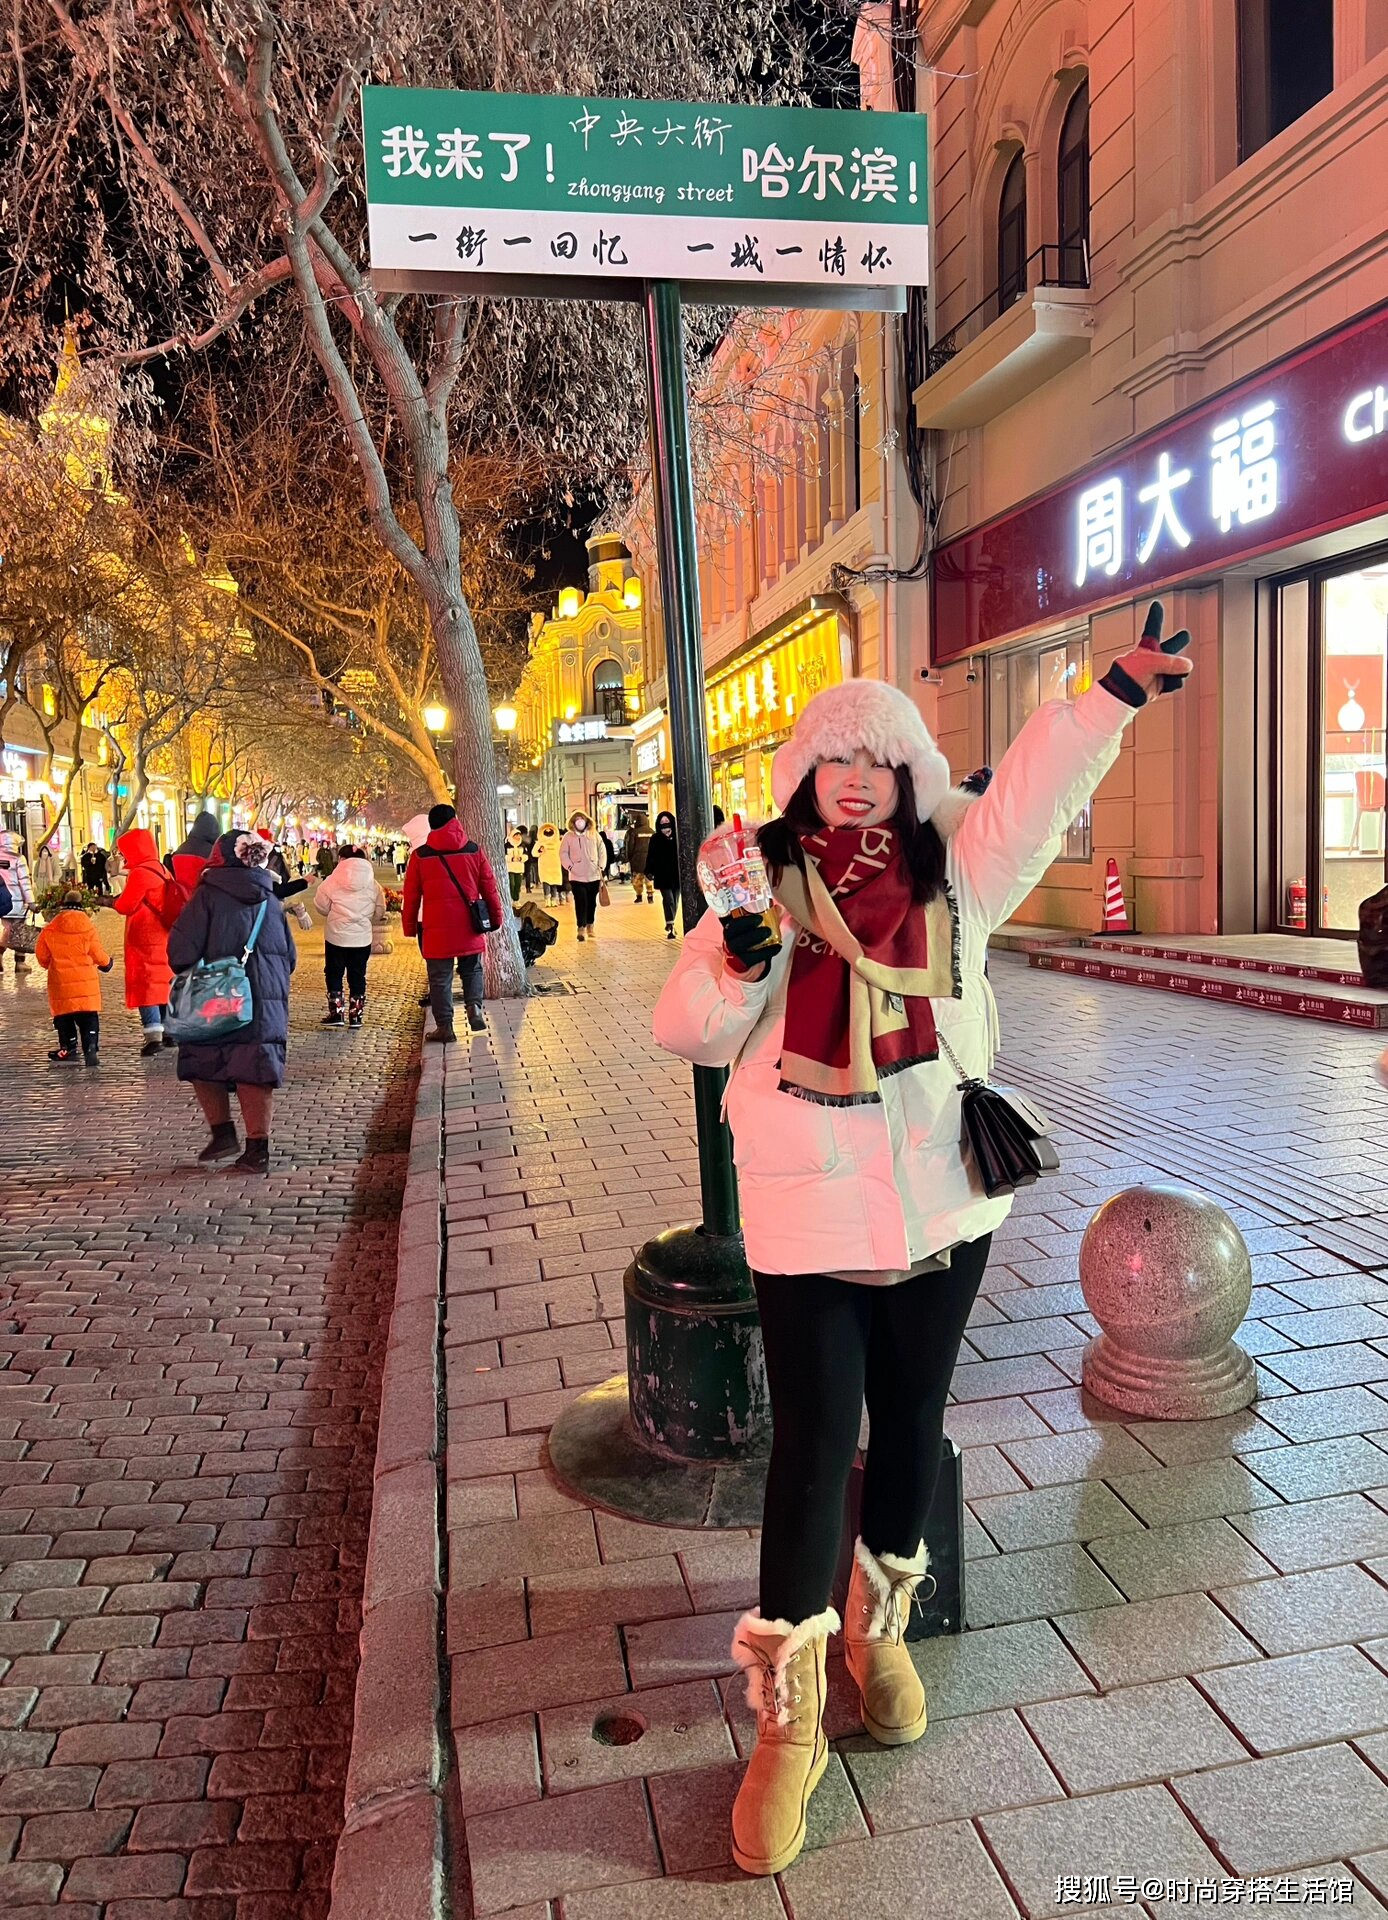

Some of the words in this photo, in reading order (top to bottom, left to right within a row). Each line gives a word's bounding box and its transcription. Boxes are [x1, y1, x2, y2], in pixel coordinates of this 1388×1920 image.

[381, 124, 556, 183] 我来了!
[742, 142, 918, 205] 哈尔滨!
[567, 179, 666, 203] zhongyang
[676, 181, 735, 202] street
[407, 226, 629, 266] 一街一回忆
[687, 234, 893, 276] 一城一情怀
[1076, 401, 1278, 587] 周大福
